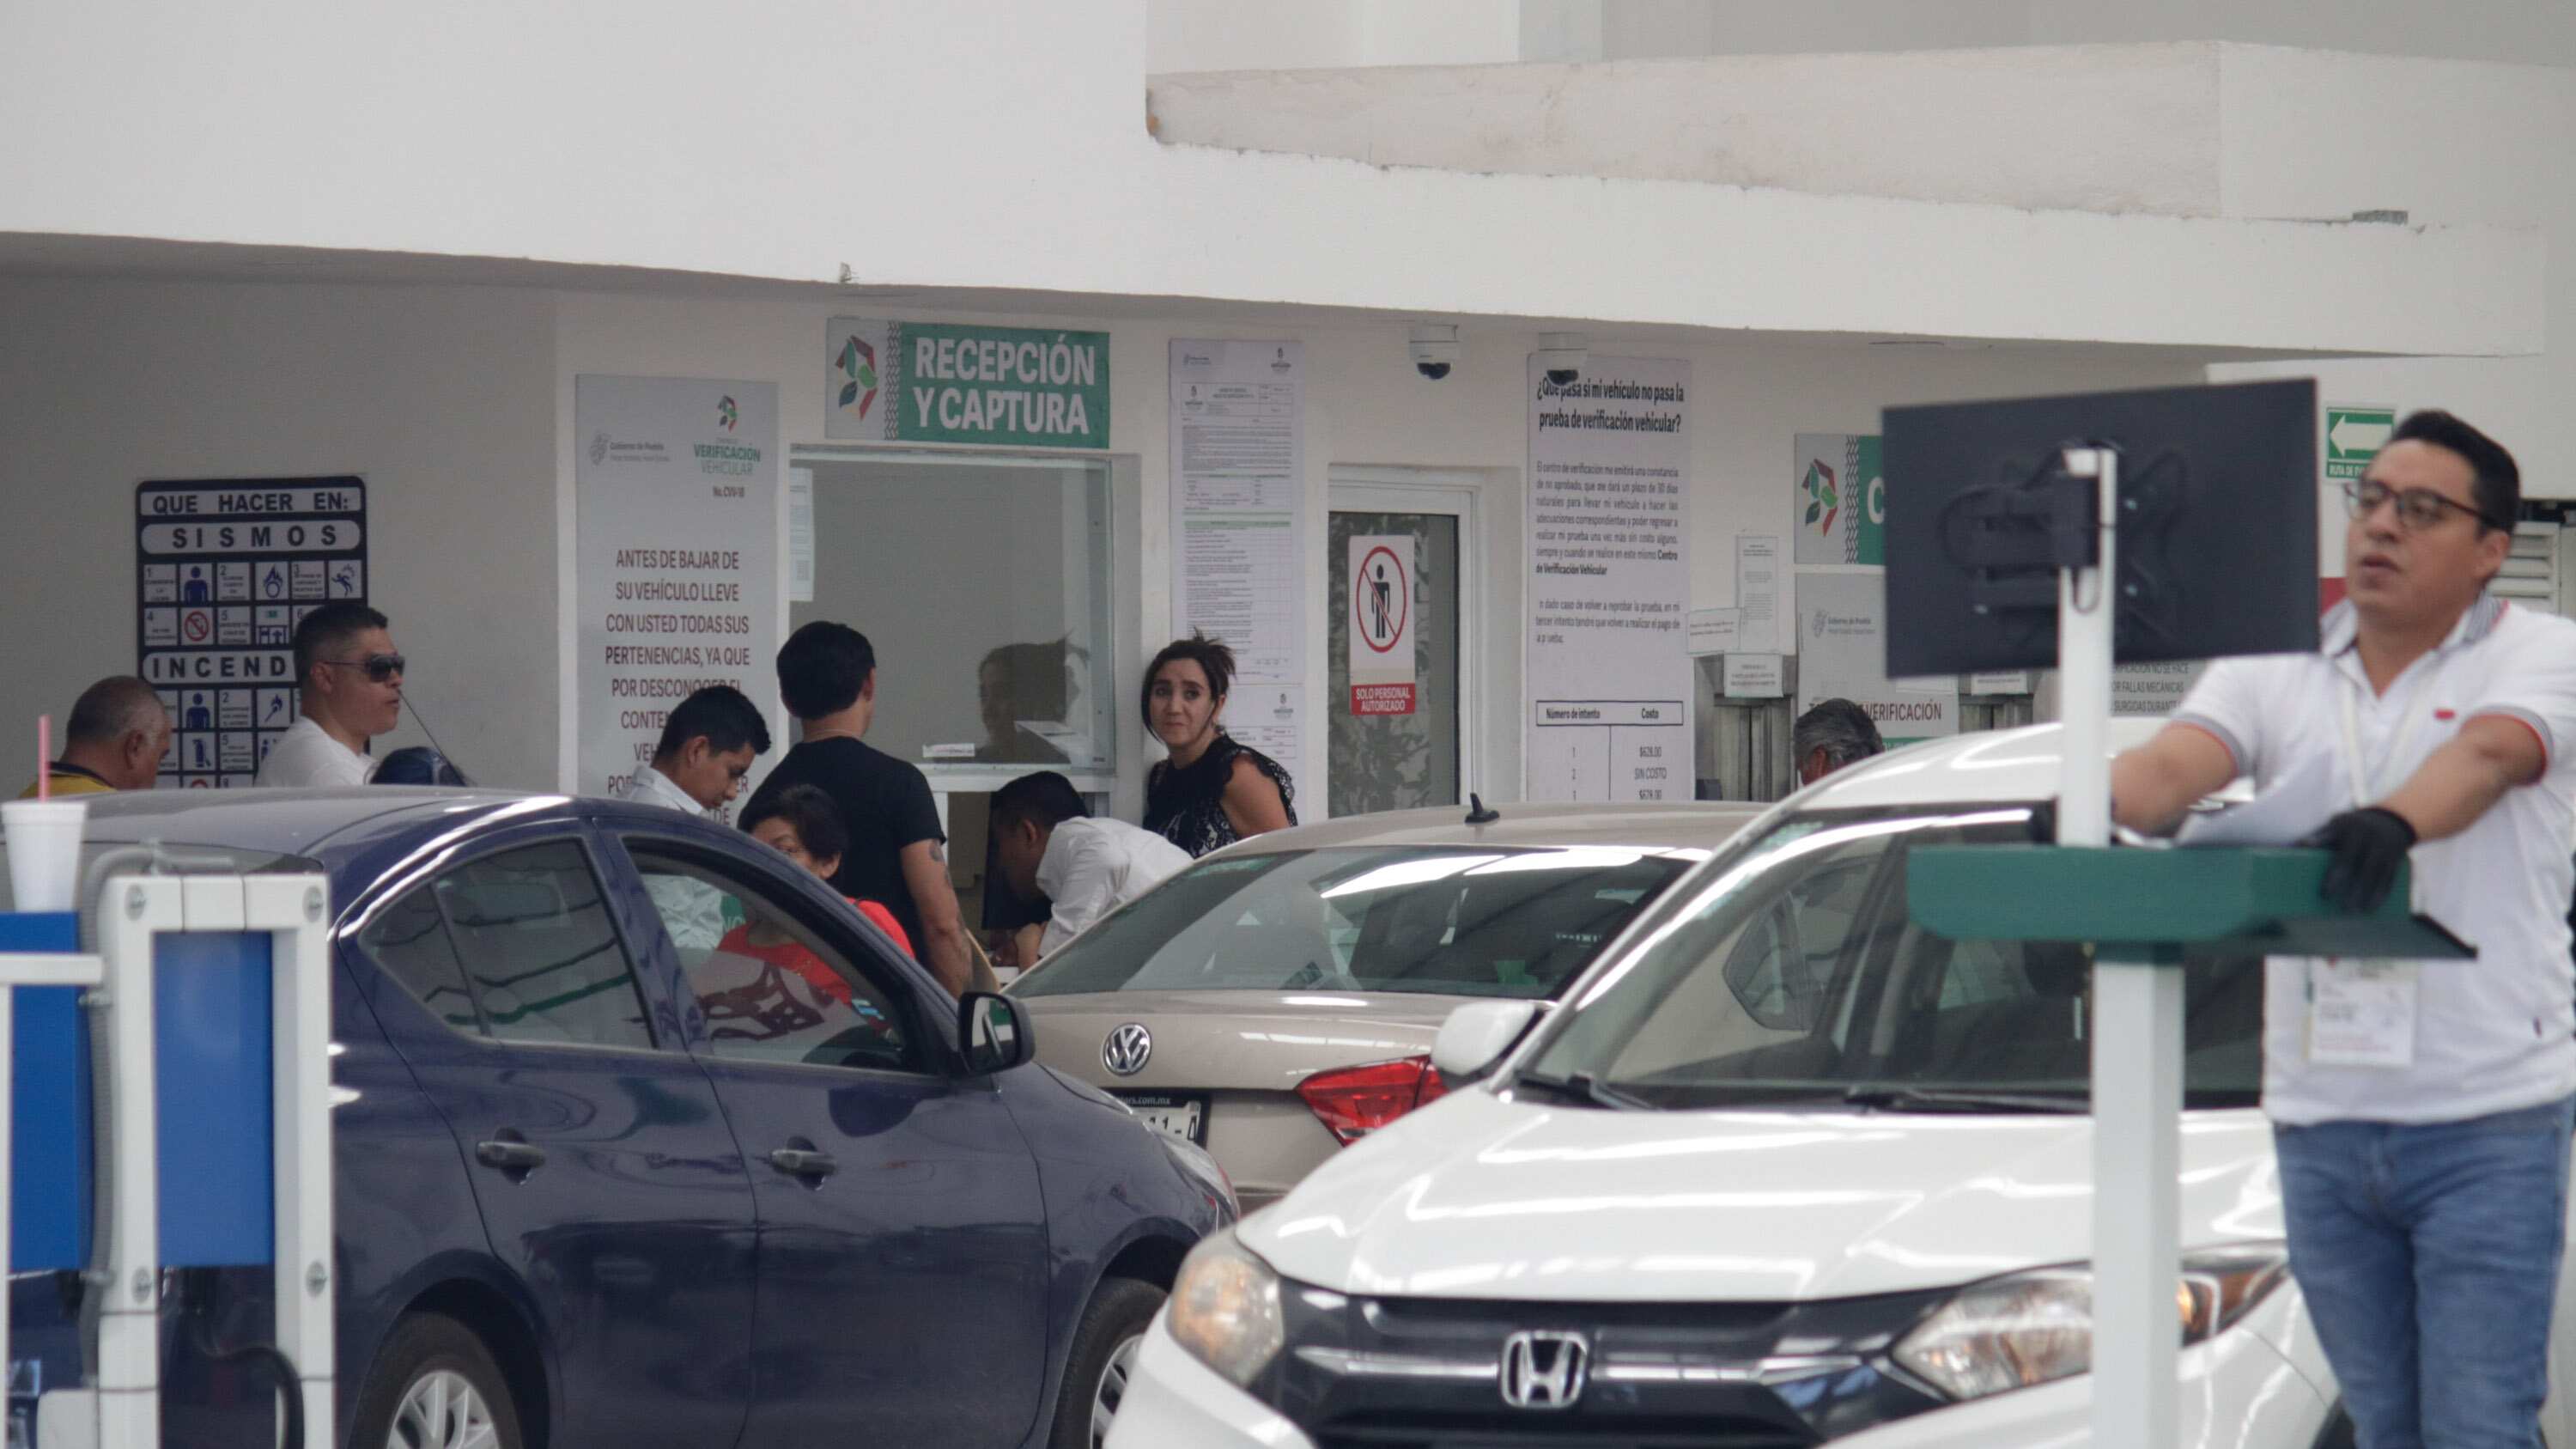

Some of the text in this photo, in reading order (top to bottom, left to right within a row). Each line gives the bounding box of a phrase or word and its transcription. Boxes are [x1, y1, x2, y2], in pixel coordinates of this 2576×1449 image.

[915, 333, 1095, 386] RECEPCIÓN
[1603, 380, 1639, 400] vehículo
[1641, 386, 1653, 400] no
[1654, 386, 1675, 405] pasa
[1676, 381, 1684, 402] la
[913, 387, 1090, 435] Y CAPTURA
[1540, 408, 1570, 431] prueba
[1571, 408, 1582, 428] de
[1635, 411, 1681, 433] vehicular?
[693, 441, 761, 462] VERIFICACIÓN
[700, 460, 754, 476] VEHICULAR
[153, 491, 349, 515] QUE HACER EN:
[172, 525, 337, 549] SISMOS
[616, 550, 739, 570] ANTES DE BAJAR DE
[616, 578, 739, 602] SU VEHÍCULO LLEVE
[606, 613, 749, 634] CON USTED TODAS SUS
[153, 655, 287, 679] INCEND
[605, 646, 750, 668] PERTENENCIAS, YA QUE
[611, 679, 727, 697] POR DESCONO
[1357, 687, 1410, 701] SOLO PERSONAL
[1361, 699, 1405, 712] AUTORIZADO
